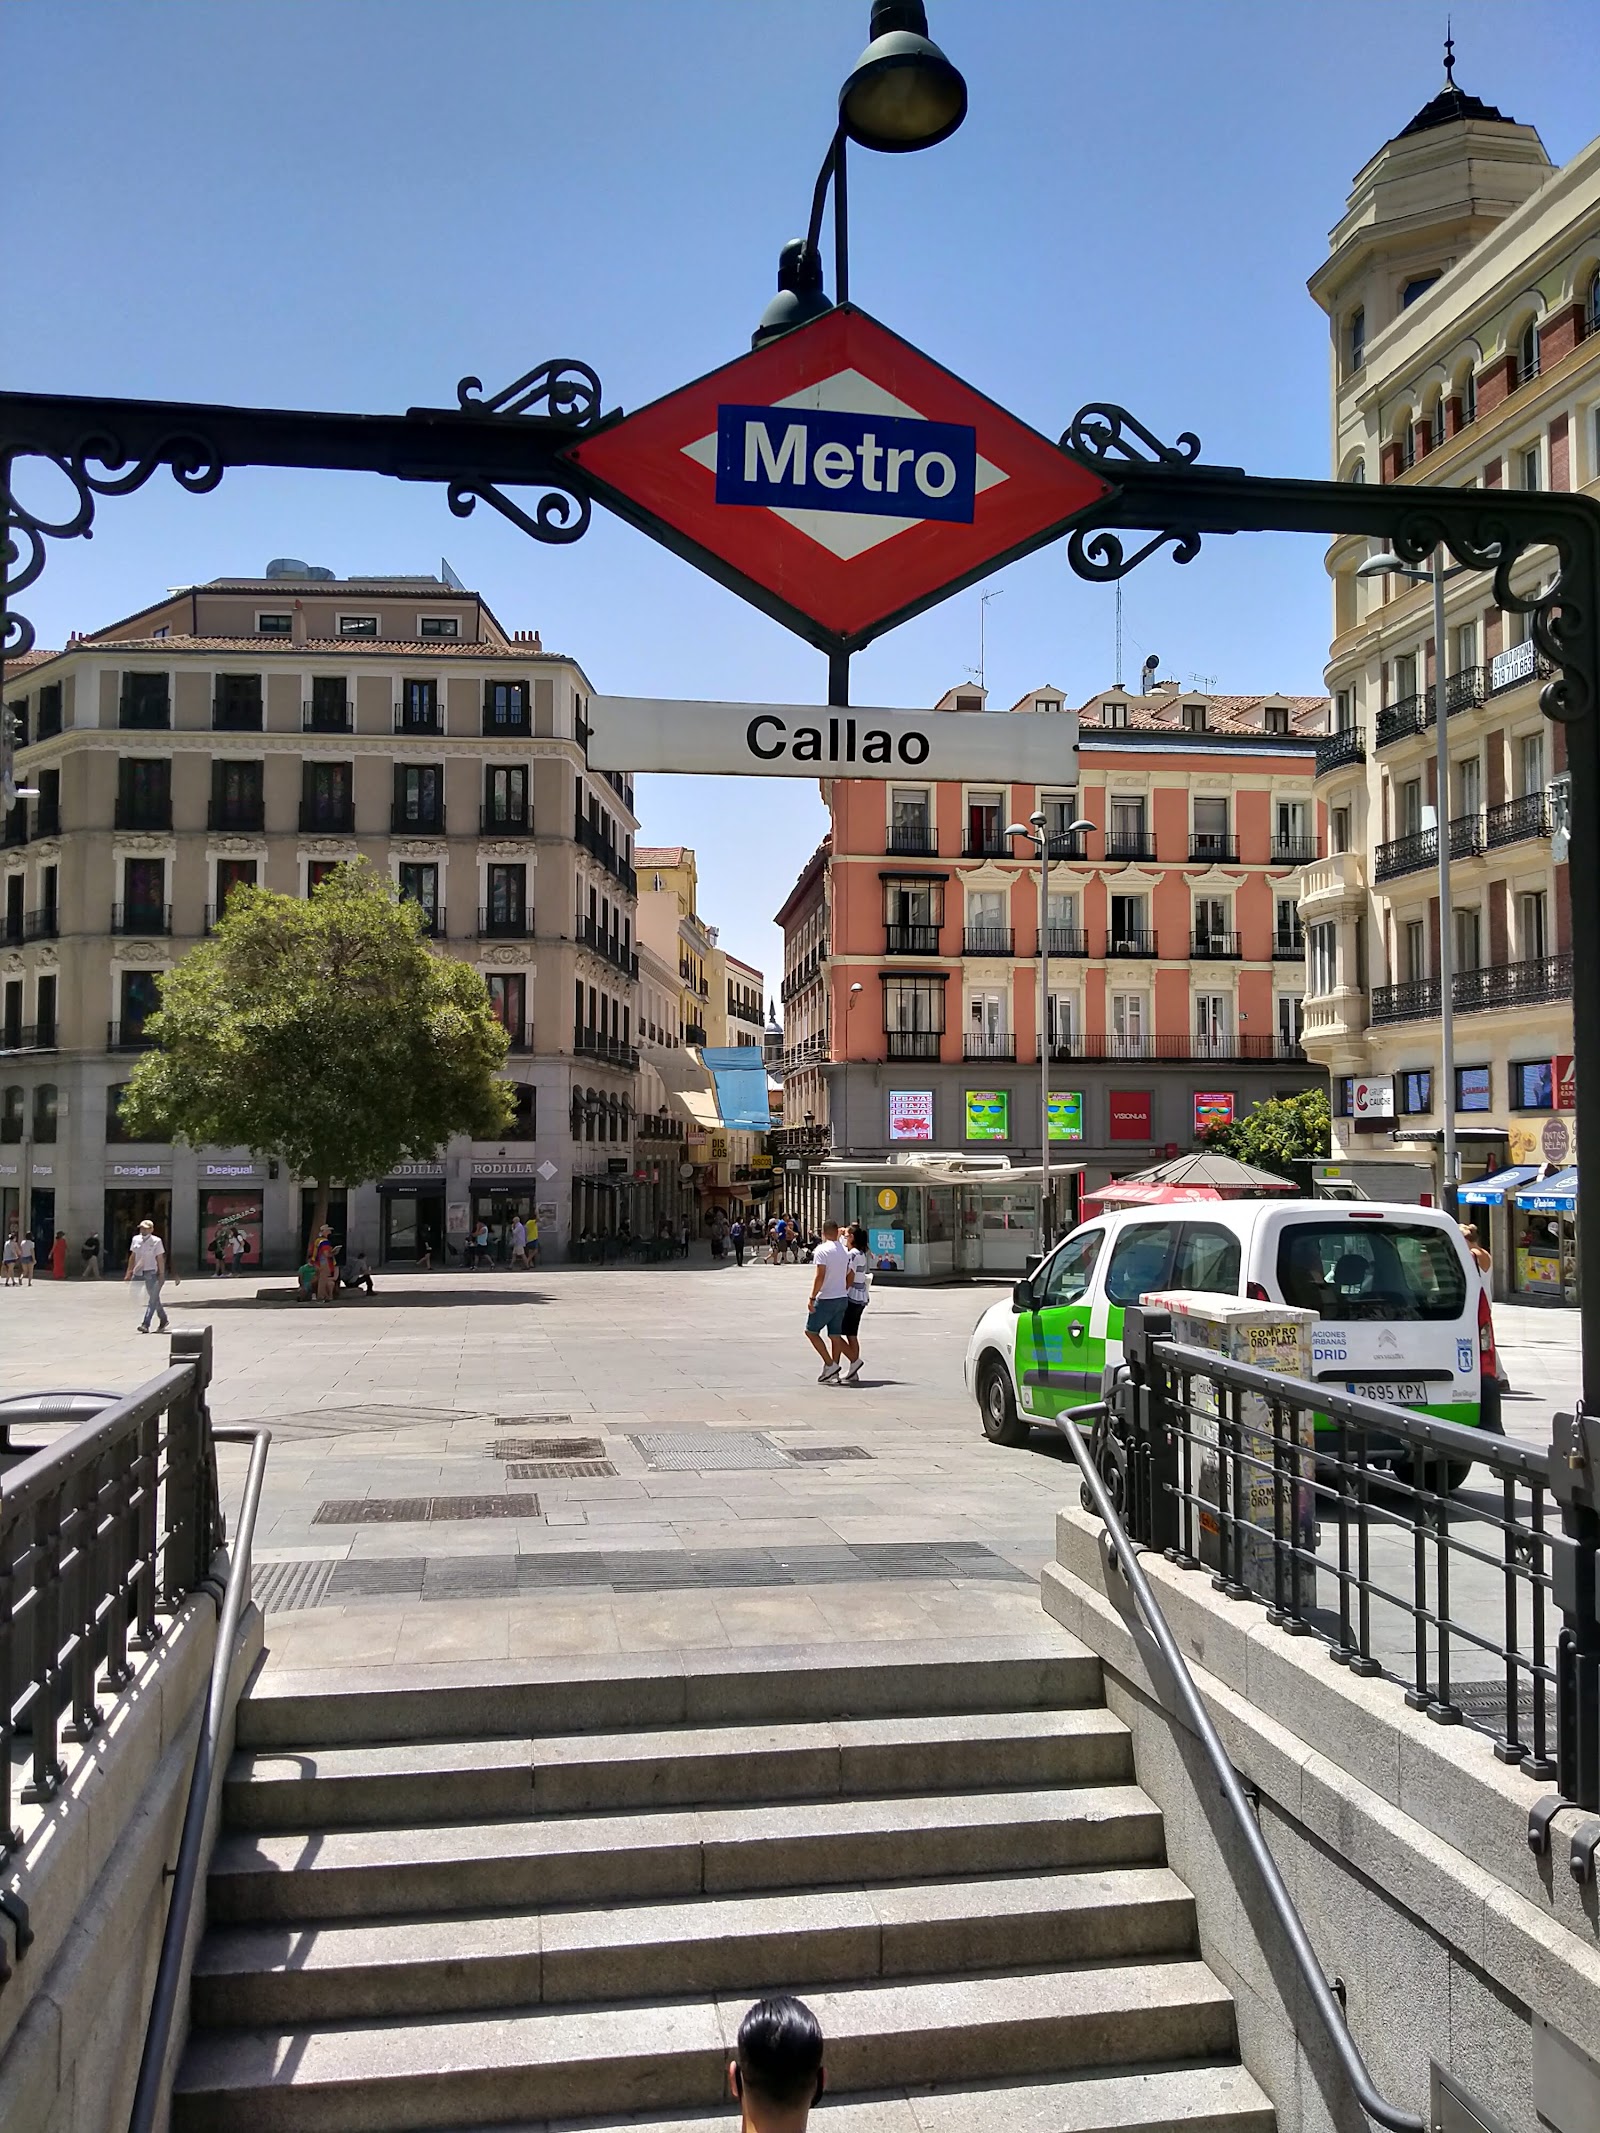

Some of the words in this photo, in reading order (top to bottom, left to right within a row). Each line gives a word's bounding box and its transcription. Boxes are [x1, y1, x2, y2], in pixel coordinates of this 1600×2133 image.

[744, 420, 957, 498] Metro
[1513, 641, 1532, 662] OFICINA
[1494, 668, 1506, 687] 619
[1506, 662, 1519, 681] 710
[1519, 655, 1532, 676] 653
[746, 714, 930, 766] Callao
[1369, 1087, 1387, 1096] GRUPO
[712, 1139, 725, 1148] DIS
[712, 1149, 728, 1158] COS
[752, 1158, 772, 1166] DISCOS
[474, 1164, 533, 1174] RODILLA
[877, 1241, 896, 1249] CIAS
[1250, 1327, 1296, 1338] COMPRO
[1251, 1335, 1297, 1348] ORO-PLATA
[1314, 1349, 1347, 1360] DRID
[1358, 1385, 1394, 1400] 2695
[1397, 1384, 1423, 1400] KPX
